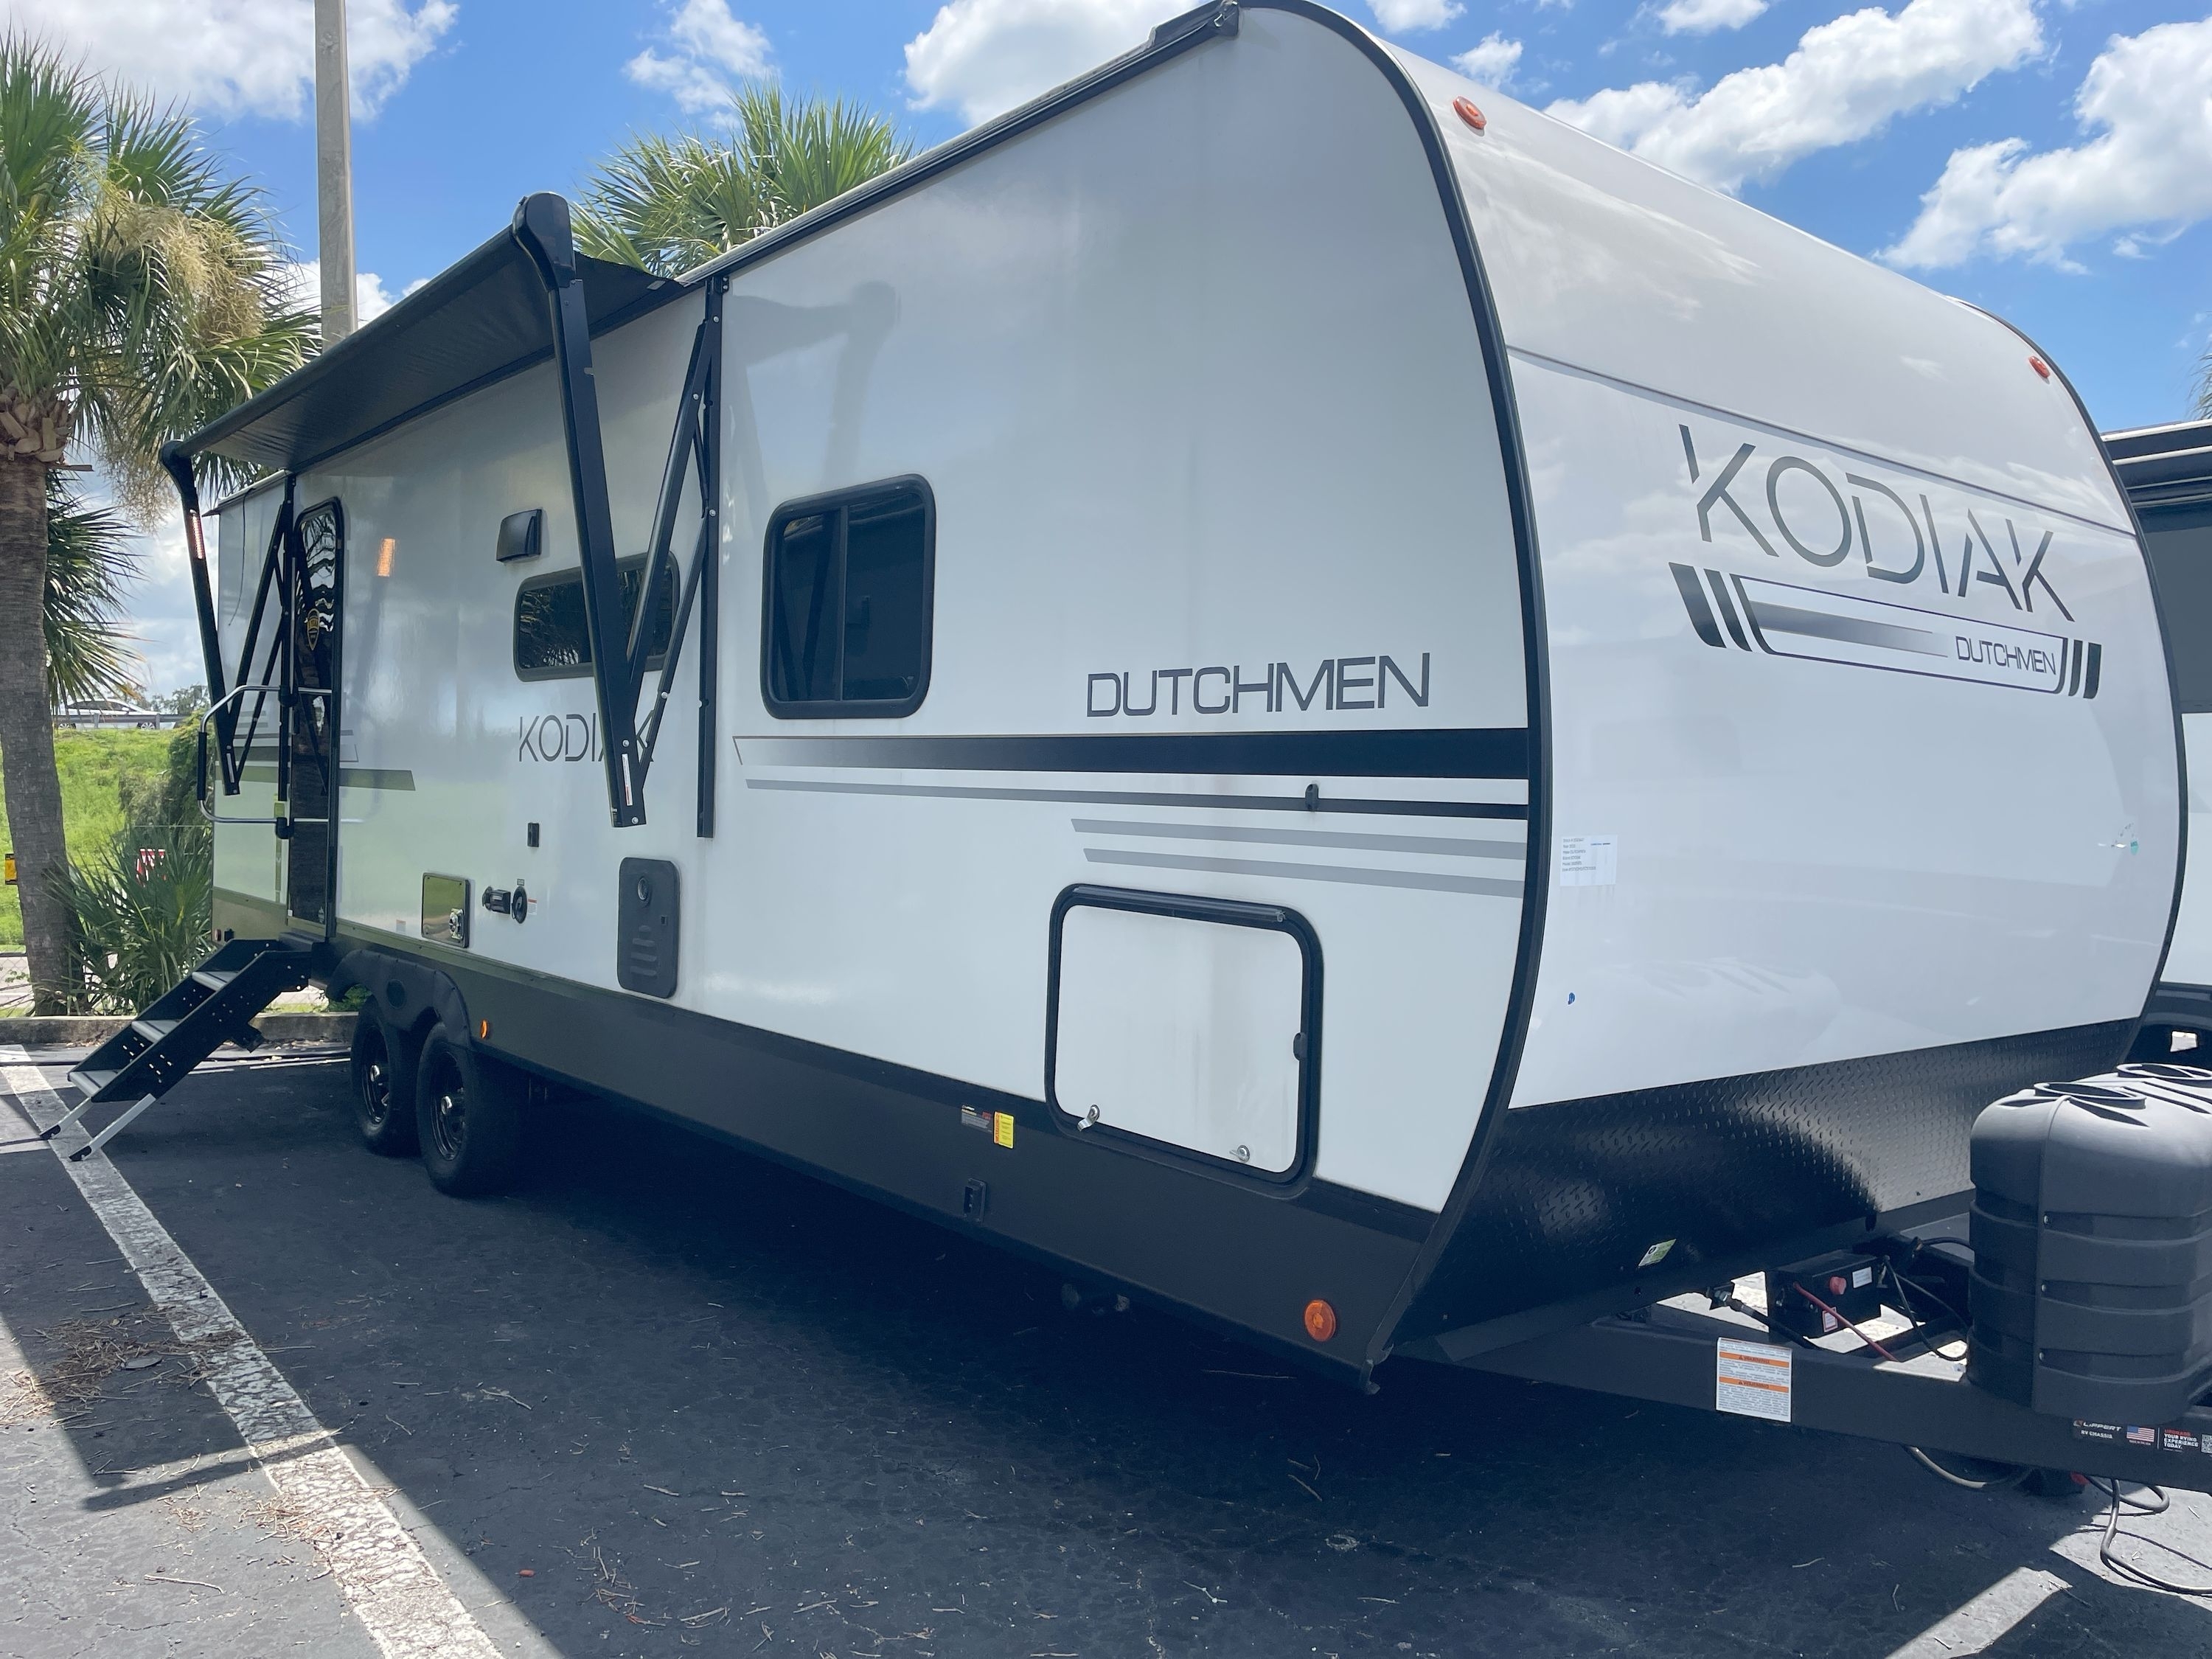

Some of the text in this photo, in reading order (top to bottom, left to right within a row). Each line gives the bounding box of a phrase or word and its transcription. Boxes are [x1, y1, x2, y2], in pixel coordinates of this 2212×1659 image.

[1678, 424, 2075, 622] KODIAK
[1955, 636, 2056, 675] DUTCHMEN
[1086, 652, 1430, 717] DUTCHMEN
[518, 712, 654, 762] KODIK
[2083, 1422, 2121, 1431] LIPPERT
[2089, 1431, 2113, 1439] CHASSIS
[2164, 1438, 2199, 1447] EXPERIENCE
